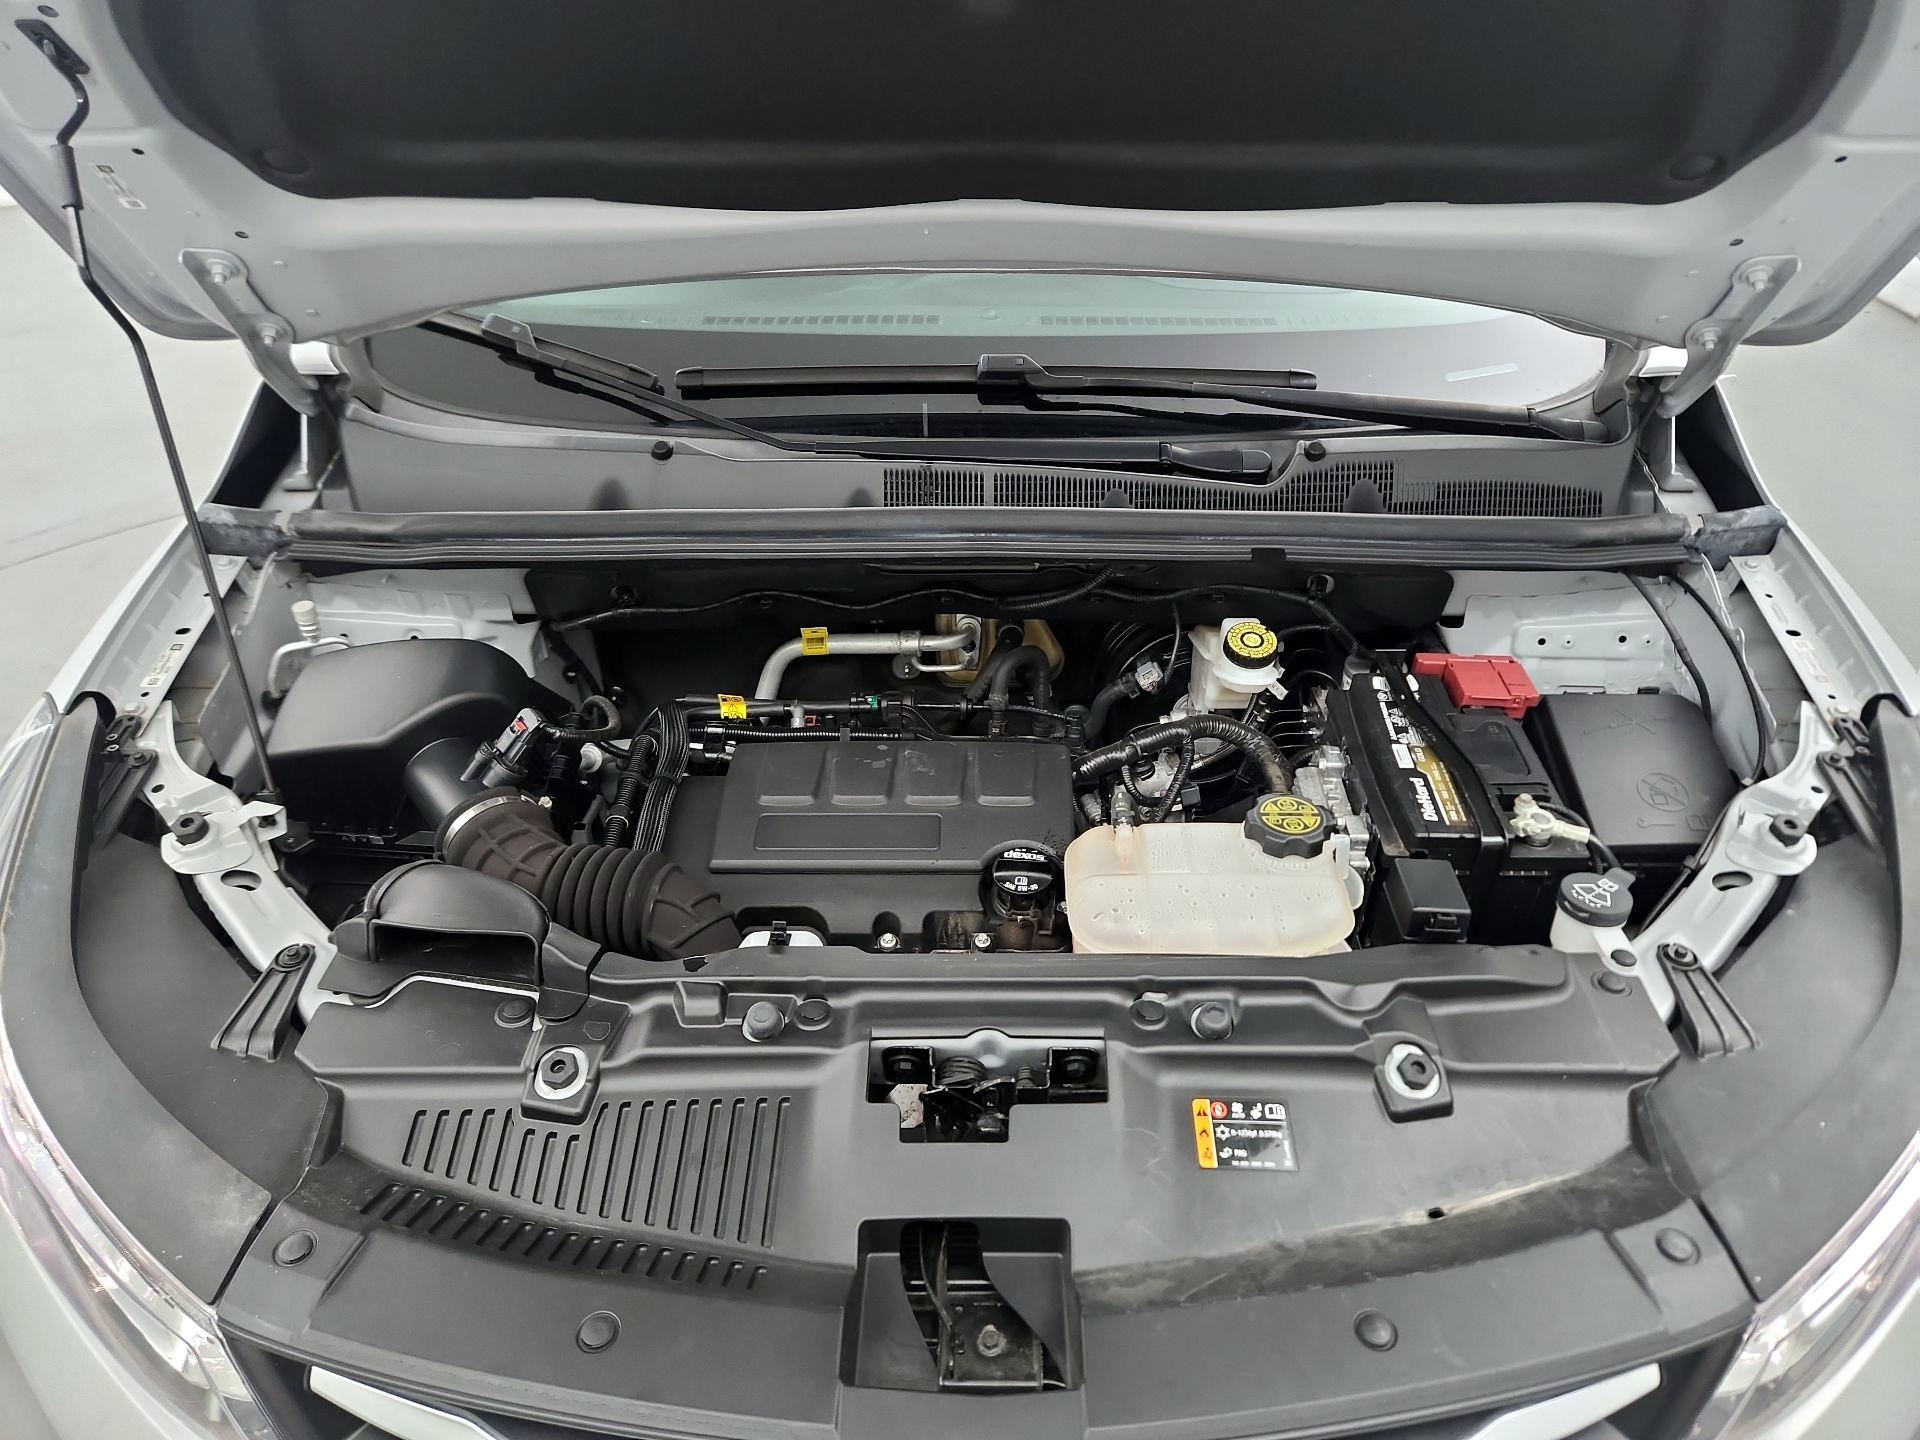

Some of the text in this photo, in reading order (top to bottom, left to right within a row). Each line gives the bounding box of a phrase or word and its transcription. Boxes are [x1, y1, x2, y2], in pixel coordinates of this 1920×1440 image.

[1409, 777, 1439, 821] DieHard
[1003, 850, 1045, 861] dexos
[1017, 884, 1039, 892] 5W-30
